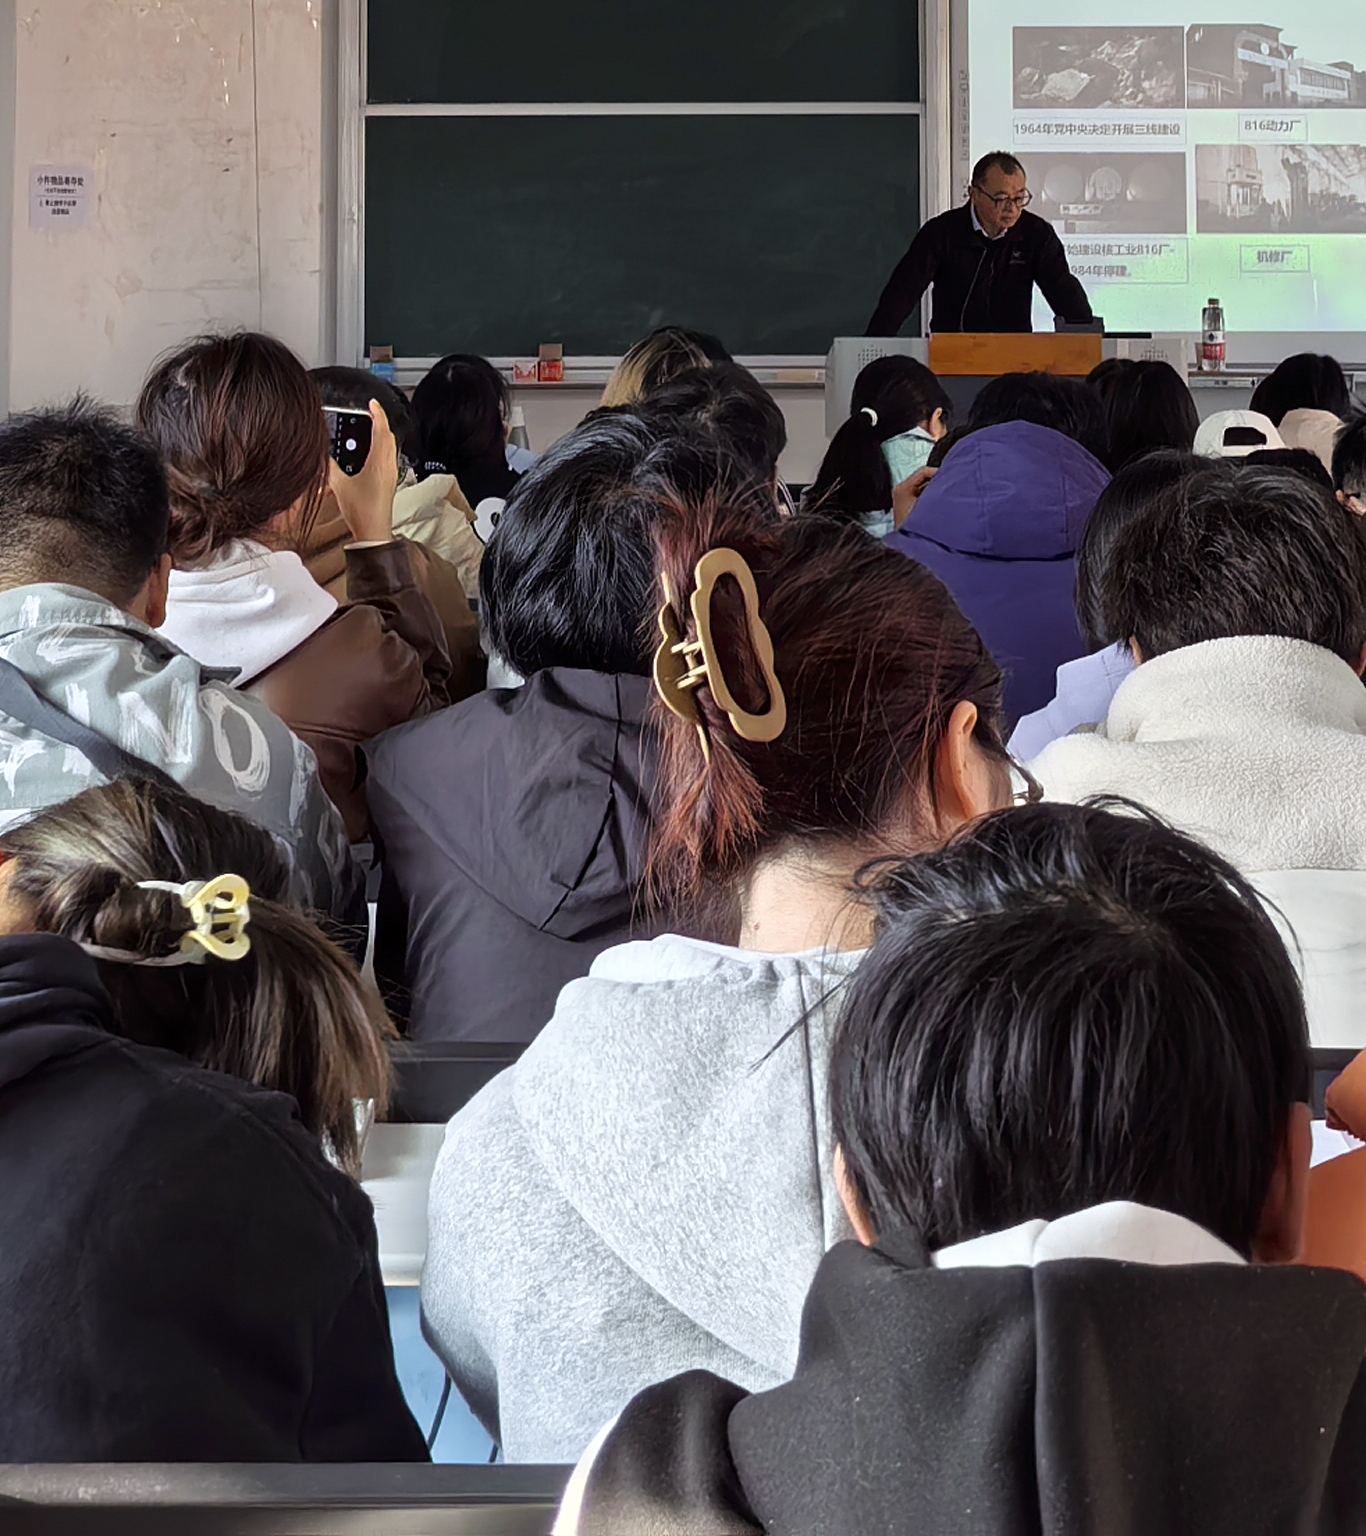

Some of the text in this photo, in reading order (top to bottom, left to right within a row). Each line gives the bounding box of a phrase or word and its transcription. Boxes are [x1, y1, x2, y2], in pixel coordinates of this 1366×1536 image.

[1014, 123, 1181, 136] 1964年党中央决定开展三线建设
[1243, 119, 1302, 132] 816动力厂
